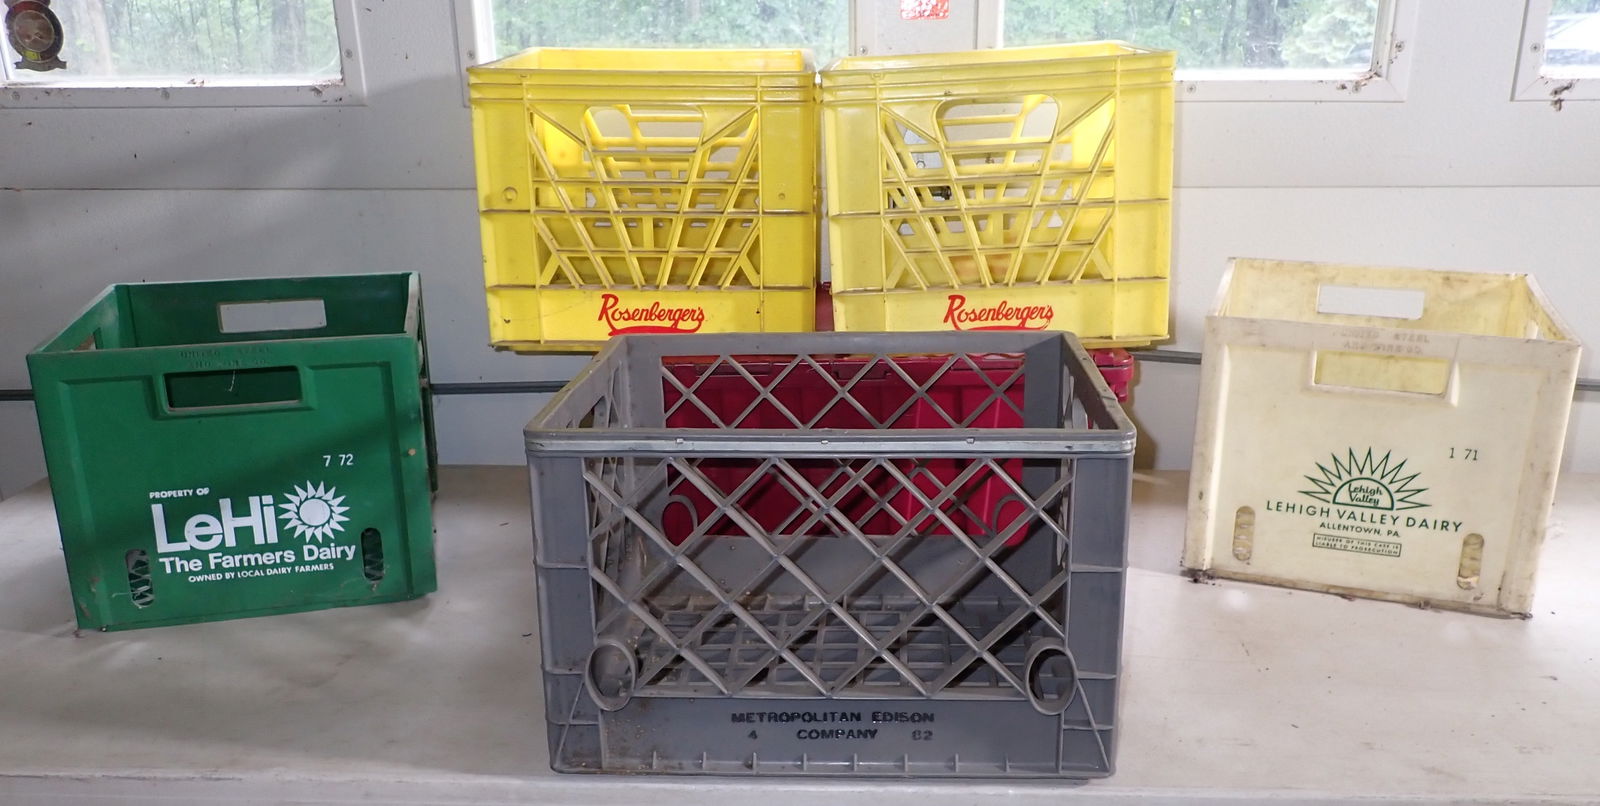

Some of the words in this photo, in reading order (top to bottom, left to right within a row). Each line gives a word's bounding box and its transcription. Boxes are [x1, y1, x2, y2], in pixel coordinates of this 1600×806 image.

[598, 293, 705, 336] Rosenberger's
[943, 294, 1054, 331] Rosenberger's
[323, 455, 331, 467] 7
[339, 453, 354, 466] 72
[1449, 447, 1456, 458] 1
[1464, 448, 1479, 461] 71
[149, 488, 194, 499] PROPERTY
[196, 487, 210, 496] OF
[1348, 484, 1382, 496] Lehigh
[1349, 493, 1379, 506] Valley
[151, 494, 278, 553] LeHi
[1266, 500, 1330, 519] LEHIGH
[1336, 508, 1400, 526] VALLEY
[1405, 517, 1463, 533] DAIRY
[158, 557, 203, 574] The
[208, 549, 296, 570] Farmers
[302, 542, 356, 562] Dairy
[188, 573, 223, 583] OWNED
[225, 571, 235, 580] BY
[237, 569, 265, 579] LOCAL
[266, 567, 292, 576] DAIRY
[295, 562, 335, 573] FARMERS
[731, 711, 862, 723] METROPOLITAN
[871, 711, 935, 723] EDISON
[748, 730, 758, 740] 4
[796, 729, 878, 740] COMPANY
